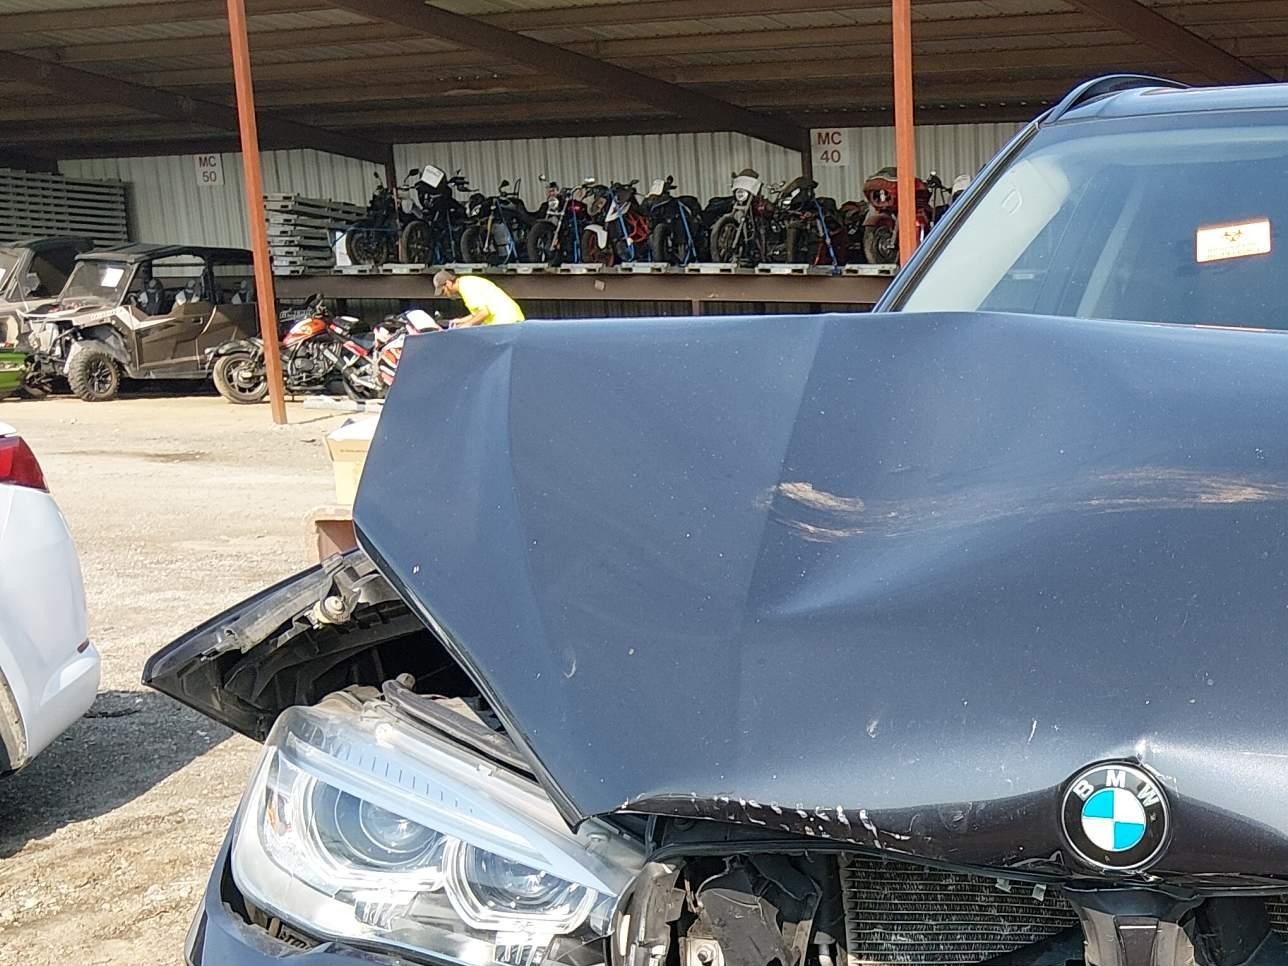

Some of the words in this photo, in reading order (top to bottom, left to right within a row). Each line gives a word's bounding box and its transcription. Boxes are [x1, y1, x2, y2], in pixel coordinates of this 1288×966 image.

[816, 131, 842, 145] MC
[198, 155, 217, 168] MC
[820, 150, 841, 163] 40
[202, 171, 217, 183] 50
[1072, 769, 1160, 807] BMW
